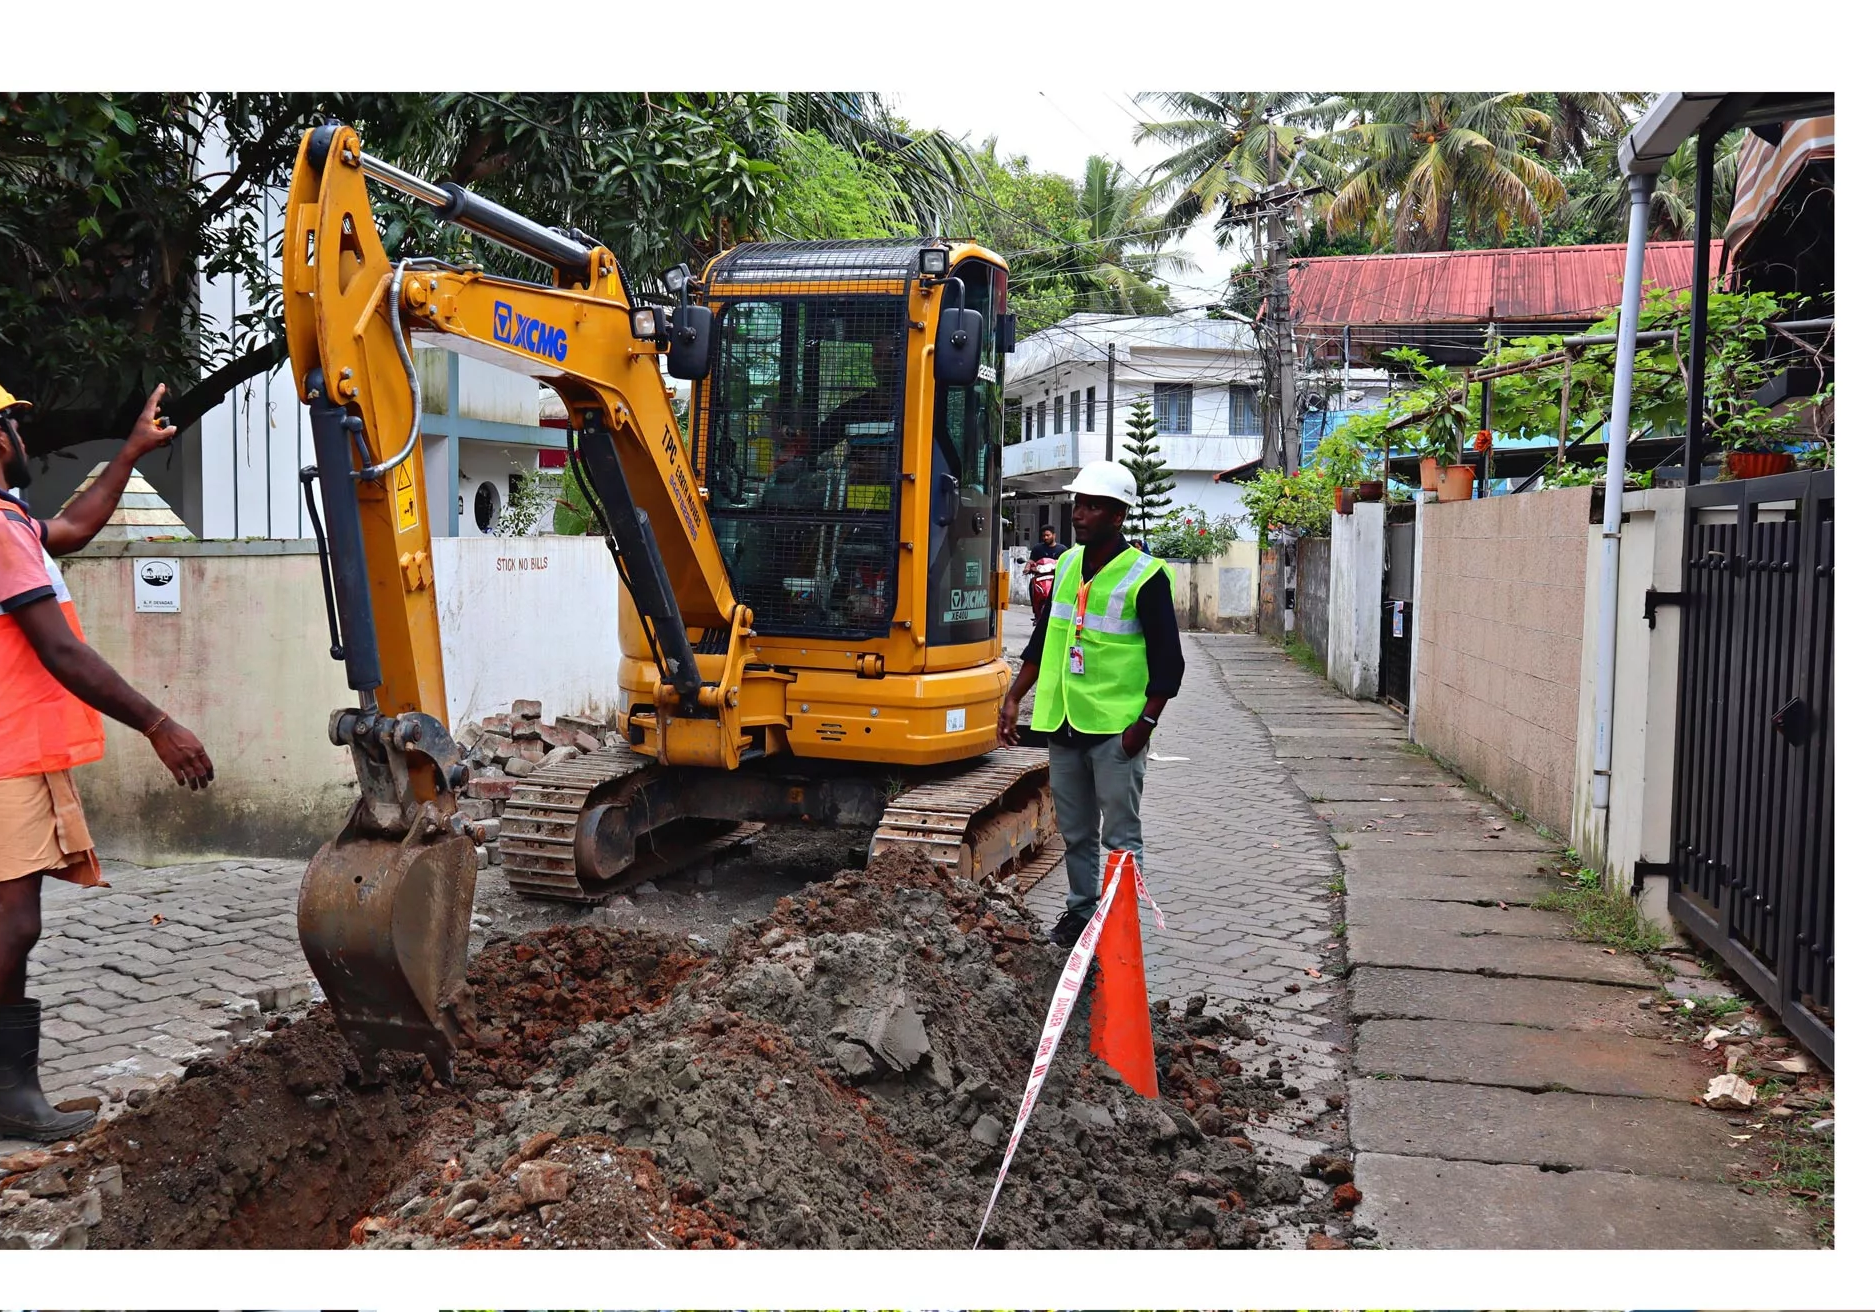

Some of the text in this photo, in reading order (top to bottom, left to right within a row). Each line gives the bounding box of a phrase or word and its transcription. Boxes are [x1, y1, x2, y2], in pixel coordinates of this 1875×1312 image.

[511, 312, 568, 362] XCMG
[661, 424, 677, 466] TPC
[497, 556, 548, 572] STICK NO BILLS
[961, 589, 987, 608] XCMG
[1079, 920, 1097, 950] DANGER
[1067, 950, 1083, 974] WORK
[1049, 996, 1065, 1028] DANGER
[1037, 1034, 1055, 1060] WORK
